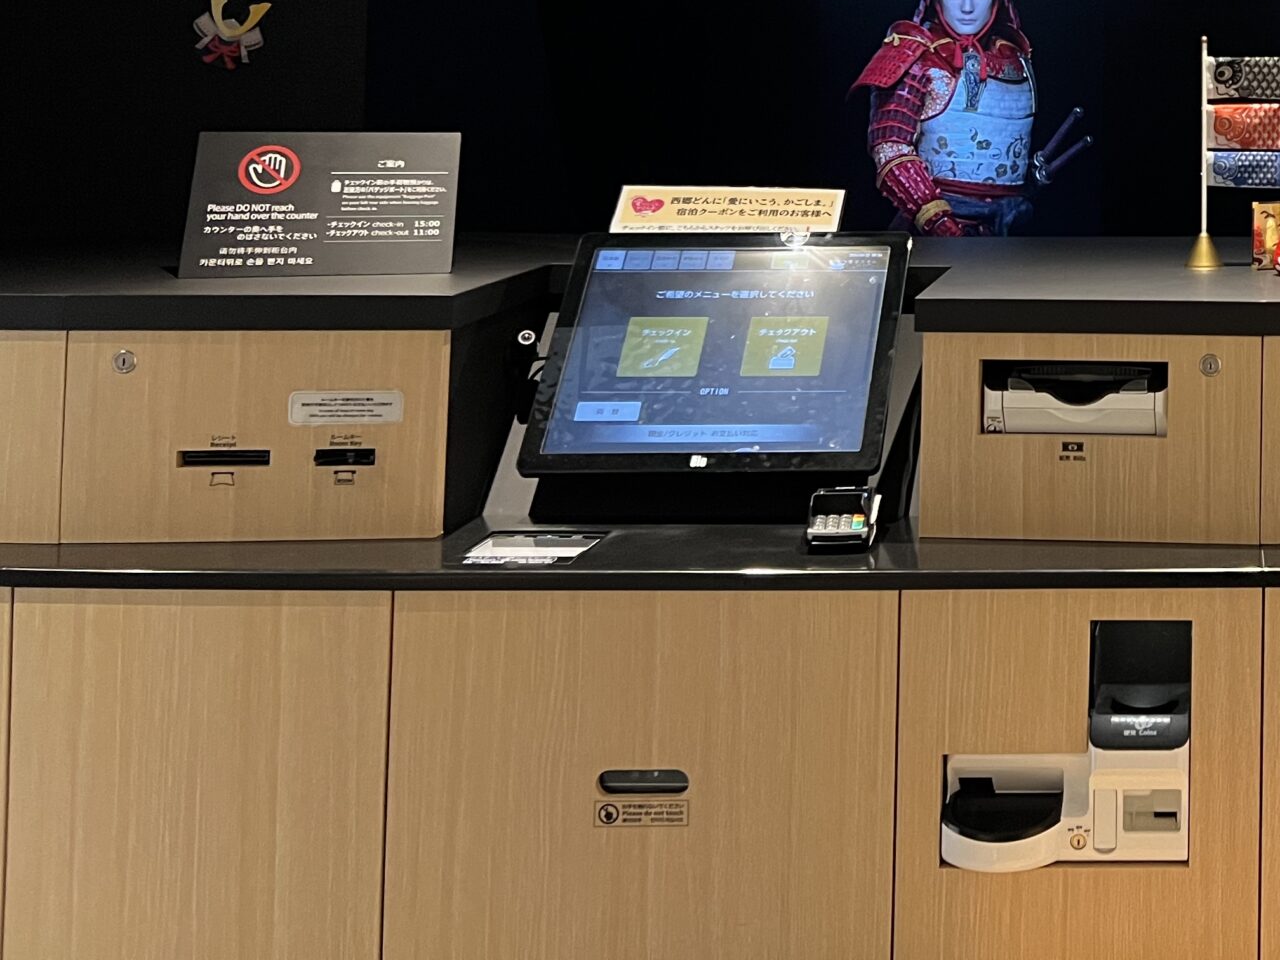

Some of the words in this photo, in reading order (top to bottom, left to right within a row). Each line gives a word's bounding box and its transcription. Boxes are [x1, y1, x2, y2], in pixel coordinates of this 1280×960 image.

[206, 203, 235, 212] Please
[235, 203, 250, 212] DO
[251, 203, 272, 212] NOT
[271, 203, 295, 212] reach
[206, 213, 227, 222] your
[227, 212, 249, 220] hand
[270, 212, 285, 220] the
[285, 212, 319, 220] counter
[676, 207, 832, 218] 宿泊クーポンをご利用のお客様へ
[414, 220, 441, 228] 15:00
[641, 328, 692, 337] チェックイン
[758, 328, 817, 337] チェックアウト
[699, 387, 729, 396] OPTION
